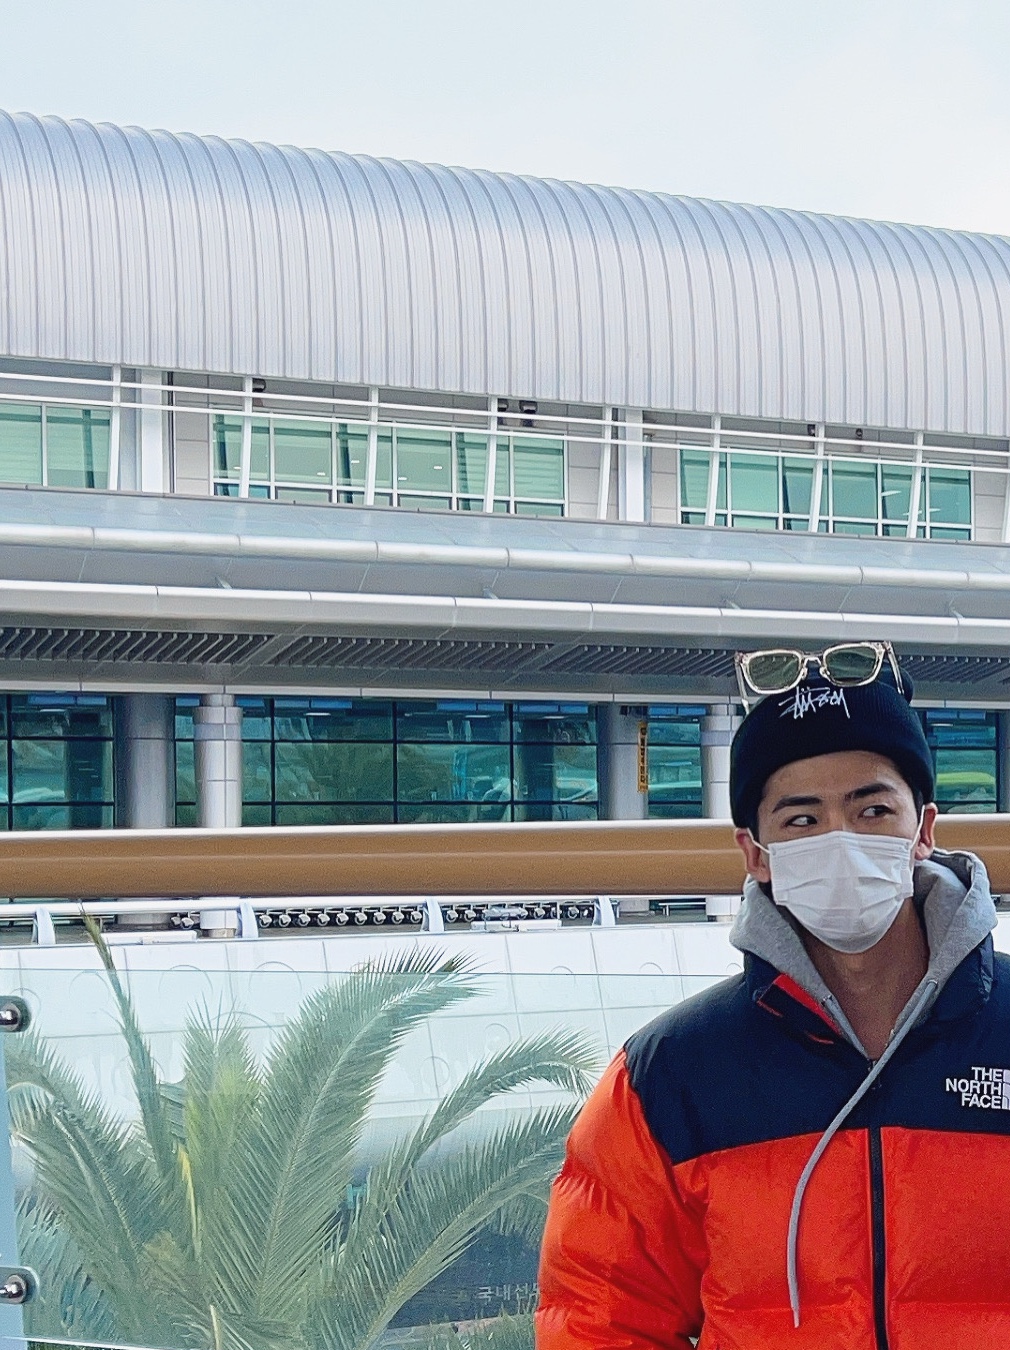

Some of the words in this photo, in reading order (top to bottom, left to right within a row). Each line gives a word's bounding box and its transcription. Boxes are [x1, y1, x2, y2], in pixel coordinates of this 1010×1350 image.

[971, 1066, 1003, 1082] THE
[945, 1078, 1002, 1095] NORTH
[961, 1093, 1002, 1109] FACE
